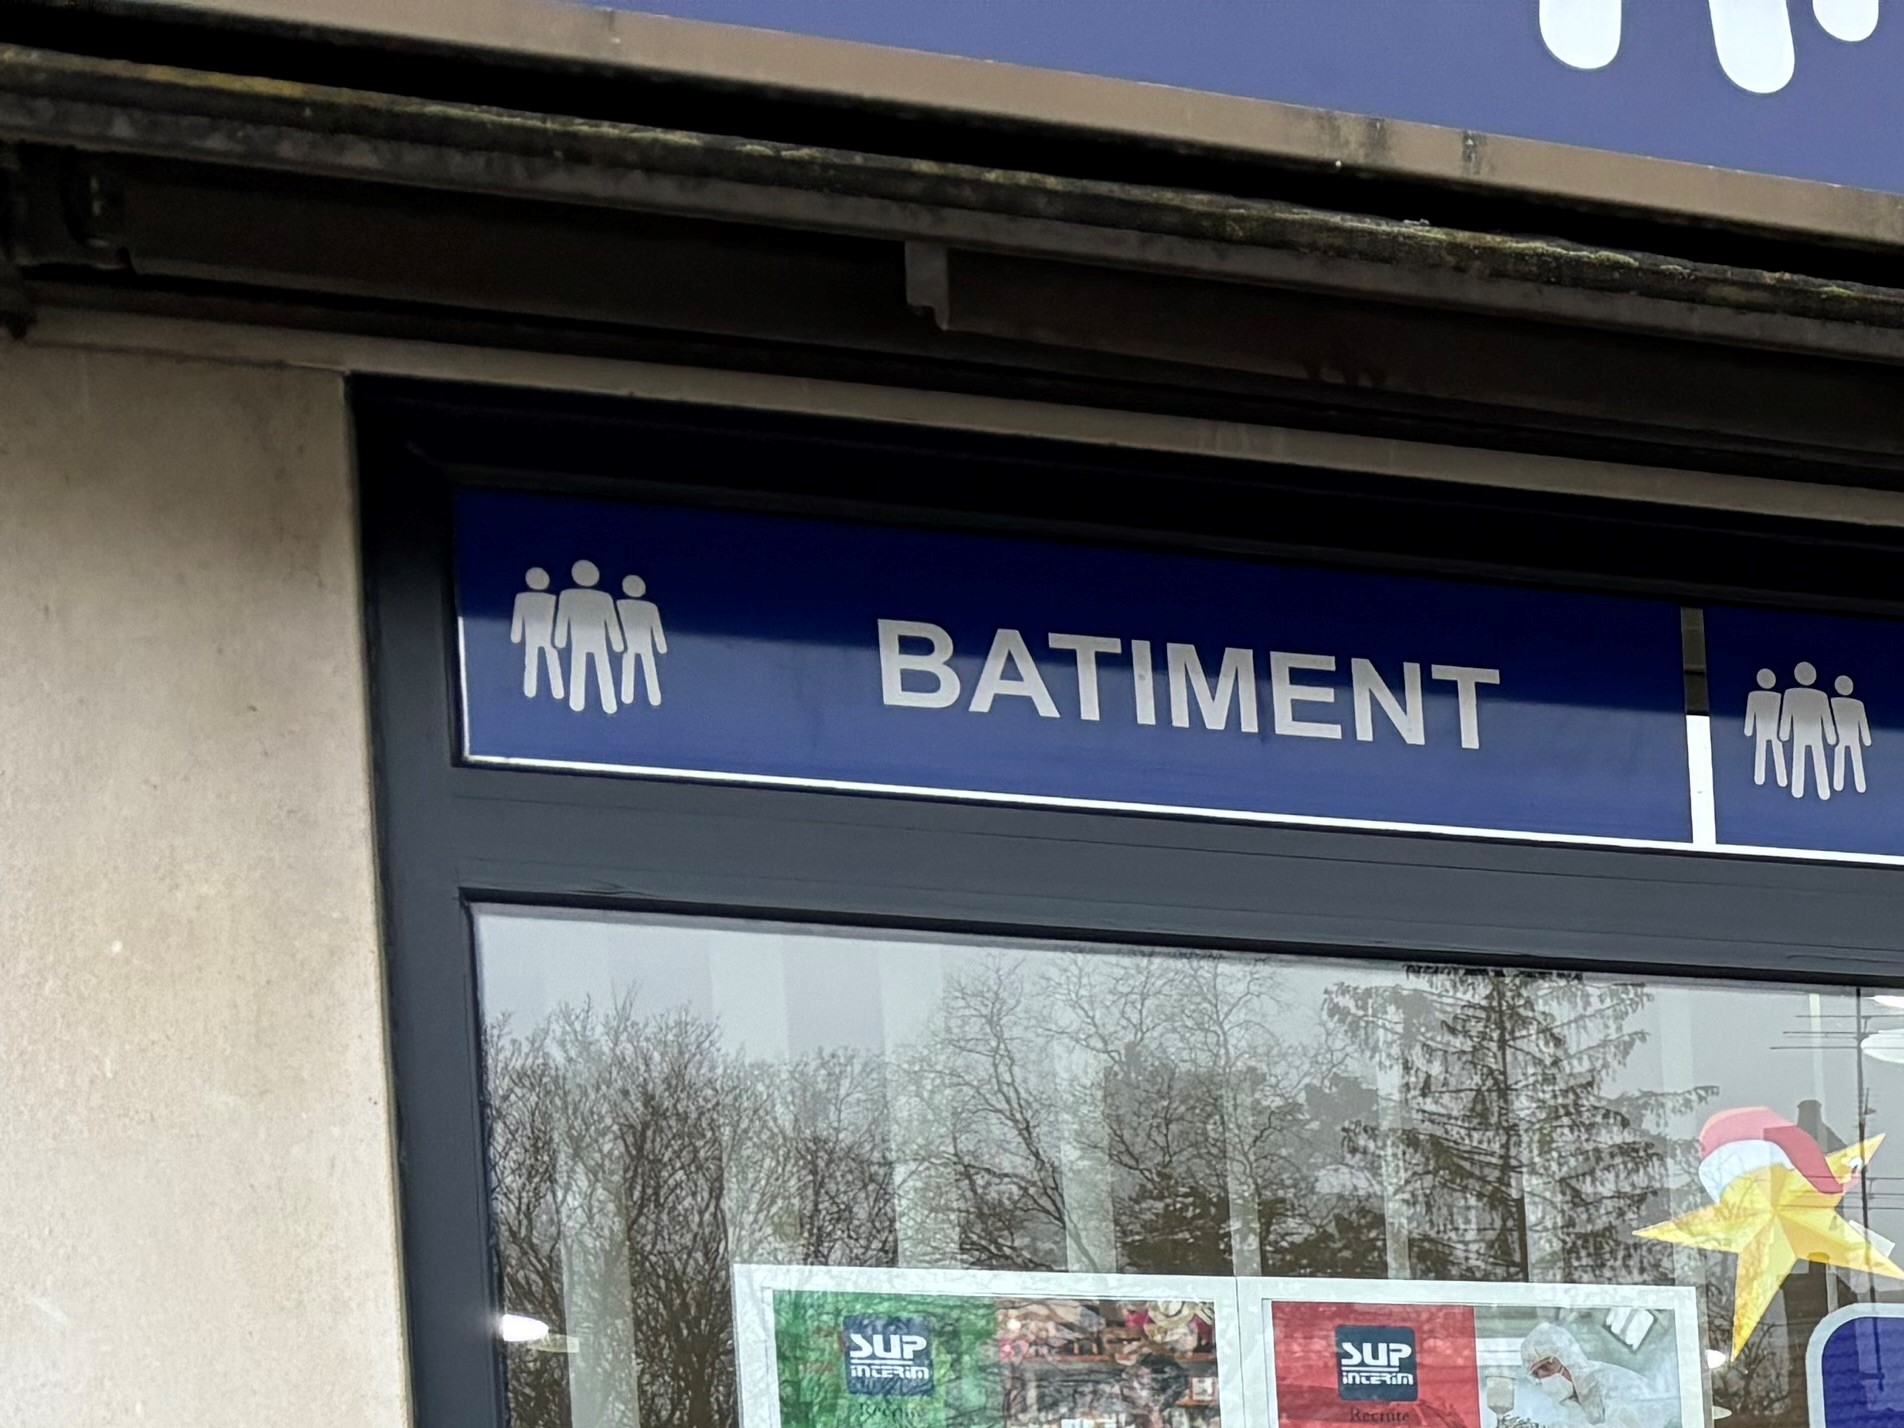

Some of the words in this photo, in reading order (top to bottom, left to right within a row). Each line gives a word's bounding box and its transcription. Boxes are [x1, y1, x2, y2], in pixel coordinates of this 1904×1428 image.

[878, 619, 1499, 749] BATIMENT
[850, 1333, 927, 1359] SUP
[1341, 1342, 1412, 1366] SUP
[1350, 1408, 1410, 1423] Recrute
